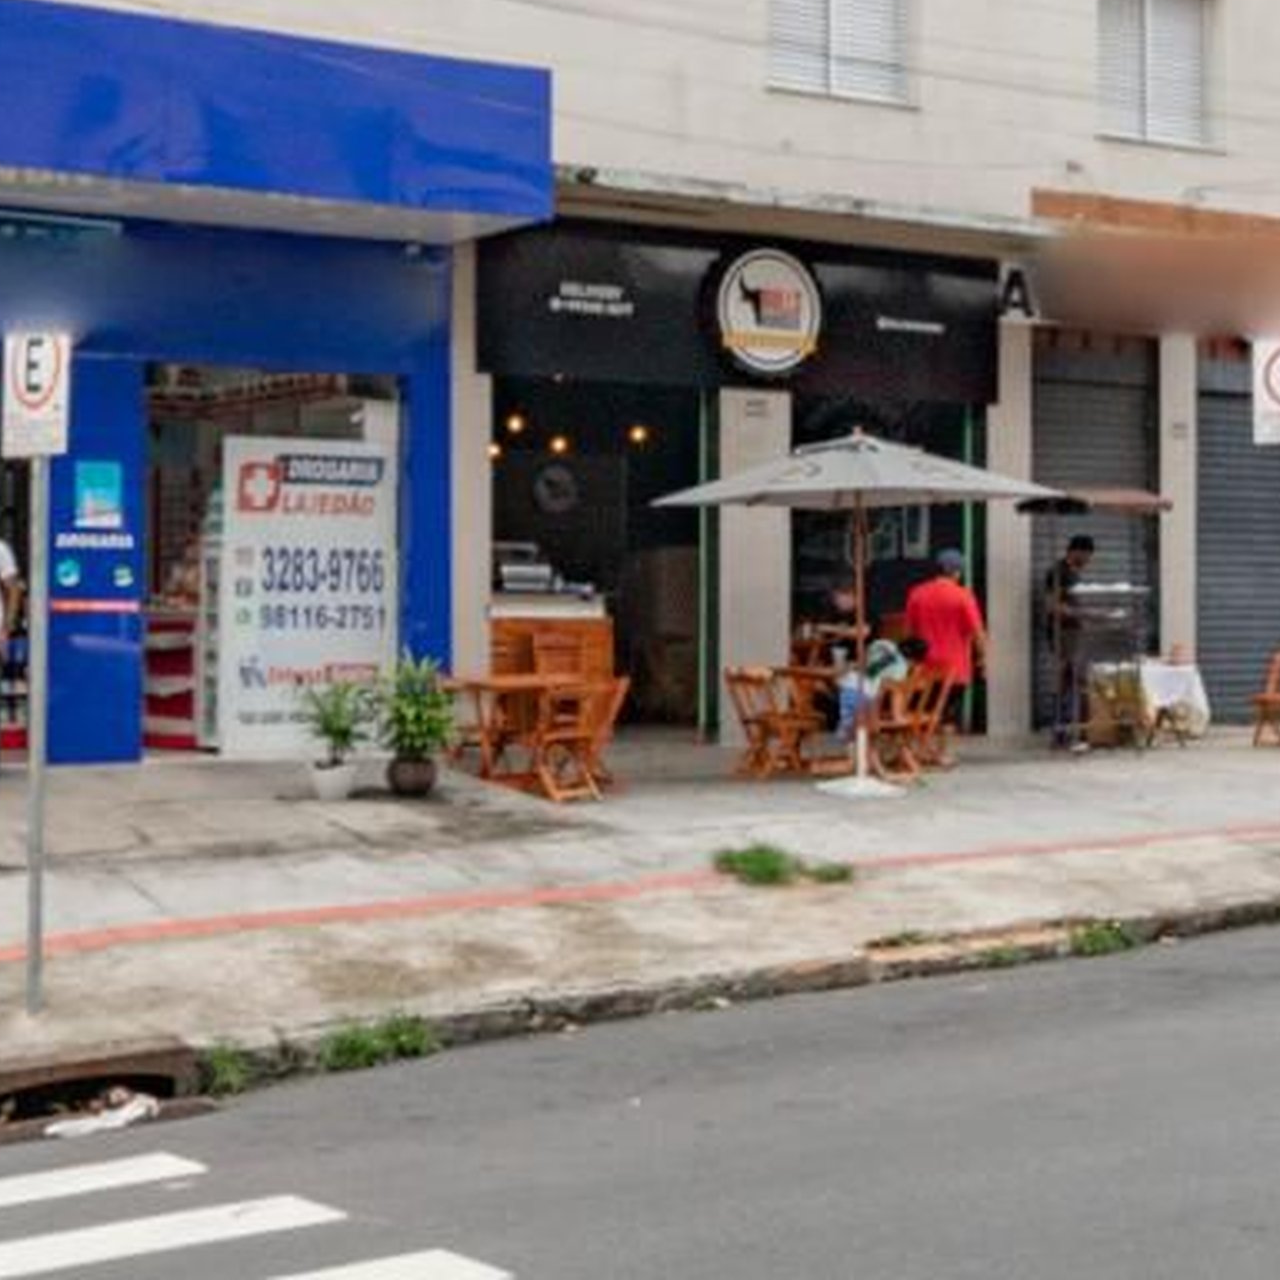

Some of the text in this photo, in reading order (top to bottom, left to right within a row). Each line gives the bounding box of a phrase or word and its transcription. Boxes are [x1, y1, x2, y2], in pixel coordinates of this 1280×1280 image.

[26, 337, 43, 393] E
[261, 544, 384, 594] 3283-9766
[259, 603, 386, 631] 98116-2751
